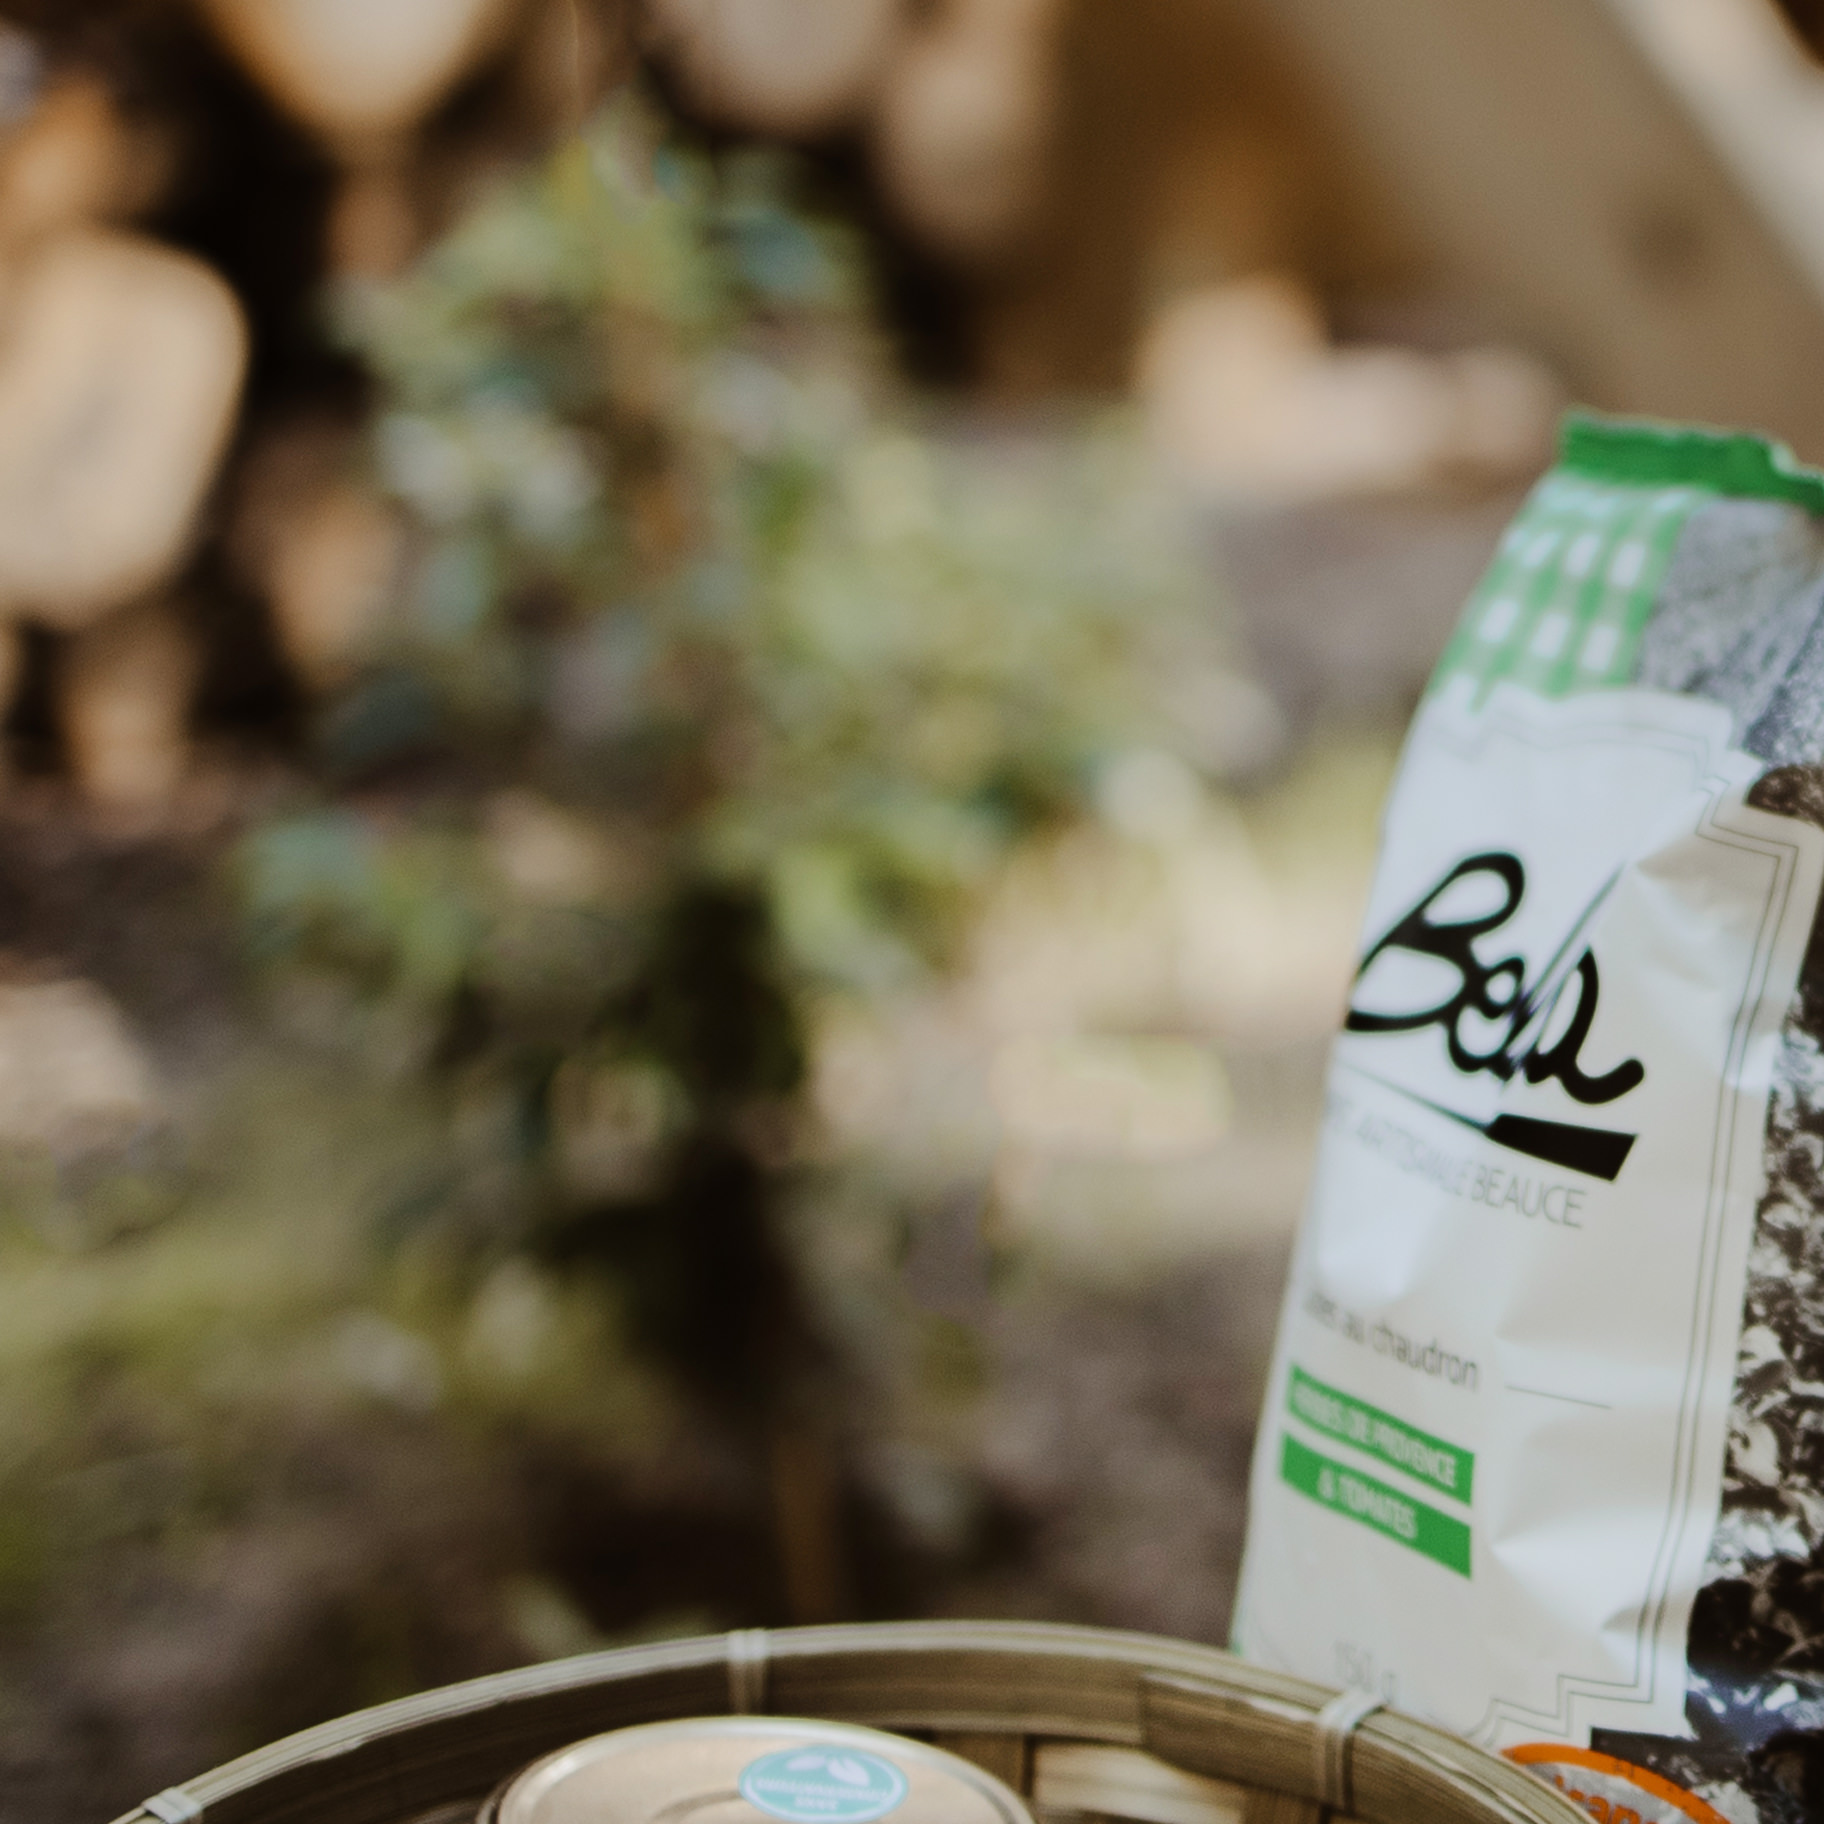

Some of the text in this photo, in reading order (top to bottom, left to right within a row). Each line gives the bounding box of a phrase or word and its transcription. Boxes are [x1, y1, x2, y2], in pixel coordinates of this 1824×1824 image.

[1471, 1161, 1587, 1229] BEAUCE
[1373, 1320, 1480, 1391] chaudron
[1371, 1416, 1457, 1489] PROVENCE
[1338, 1473, 1417, 1540] TOMATES
